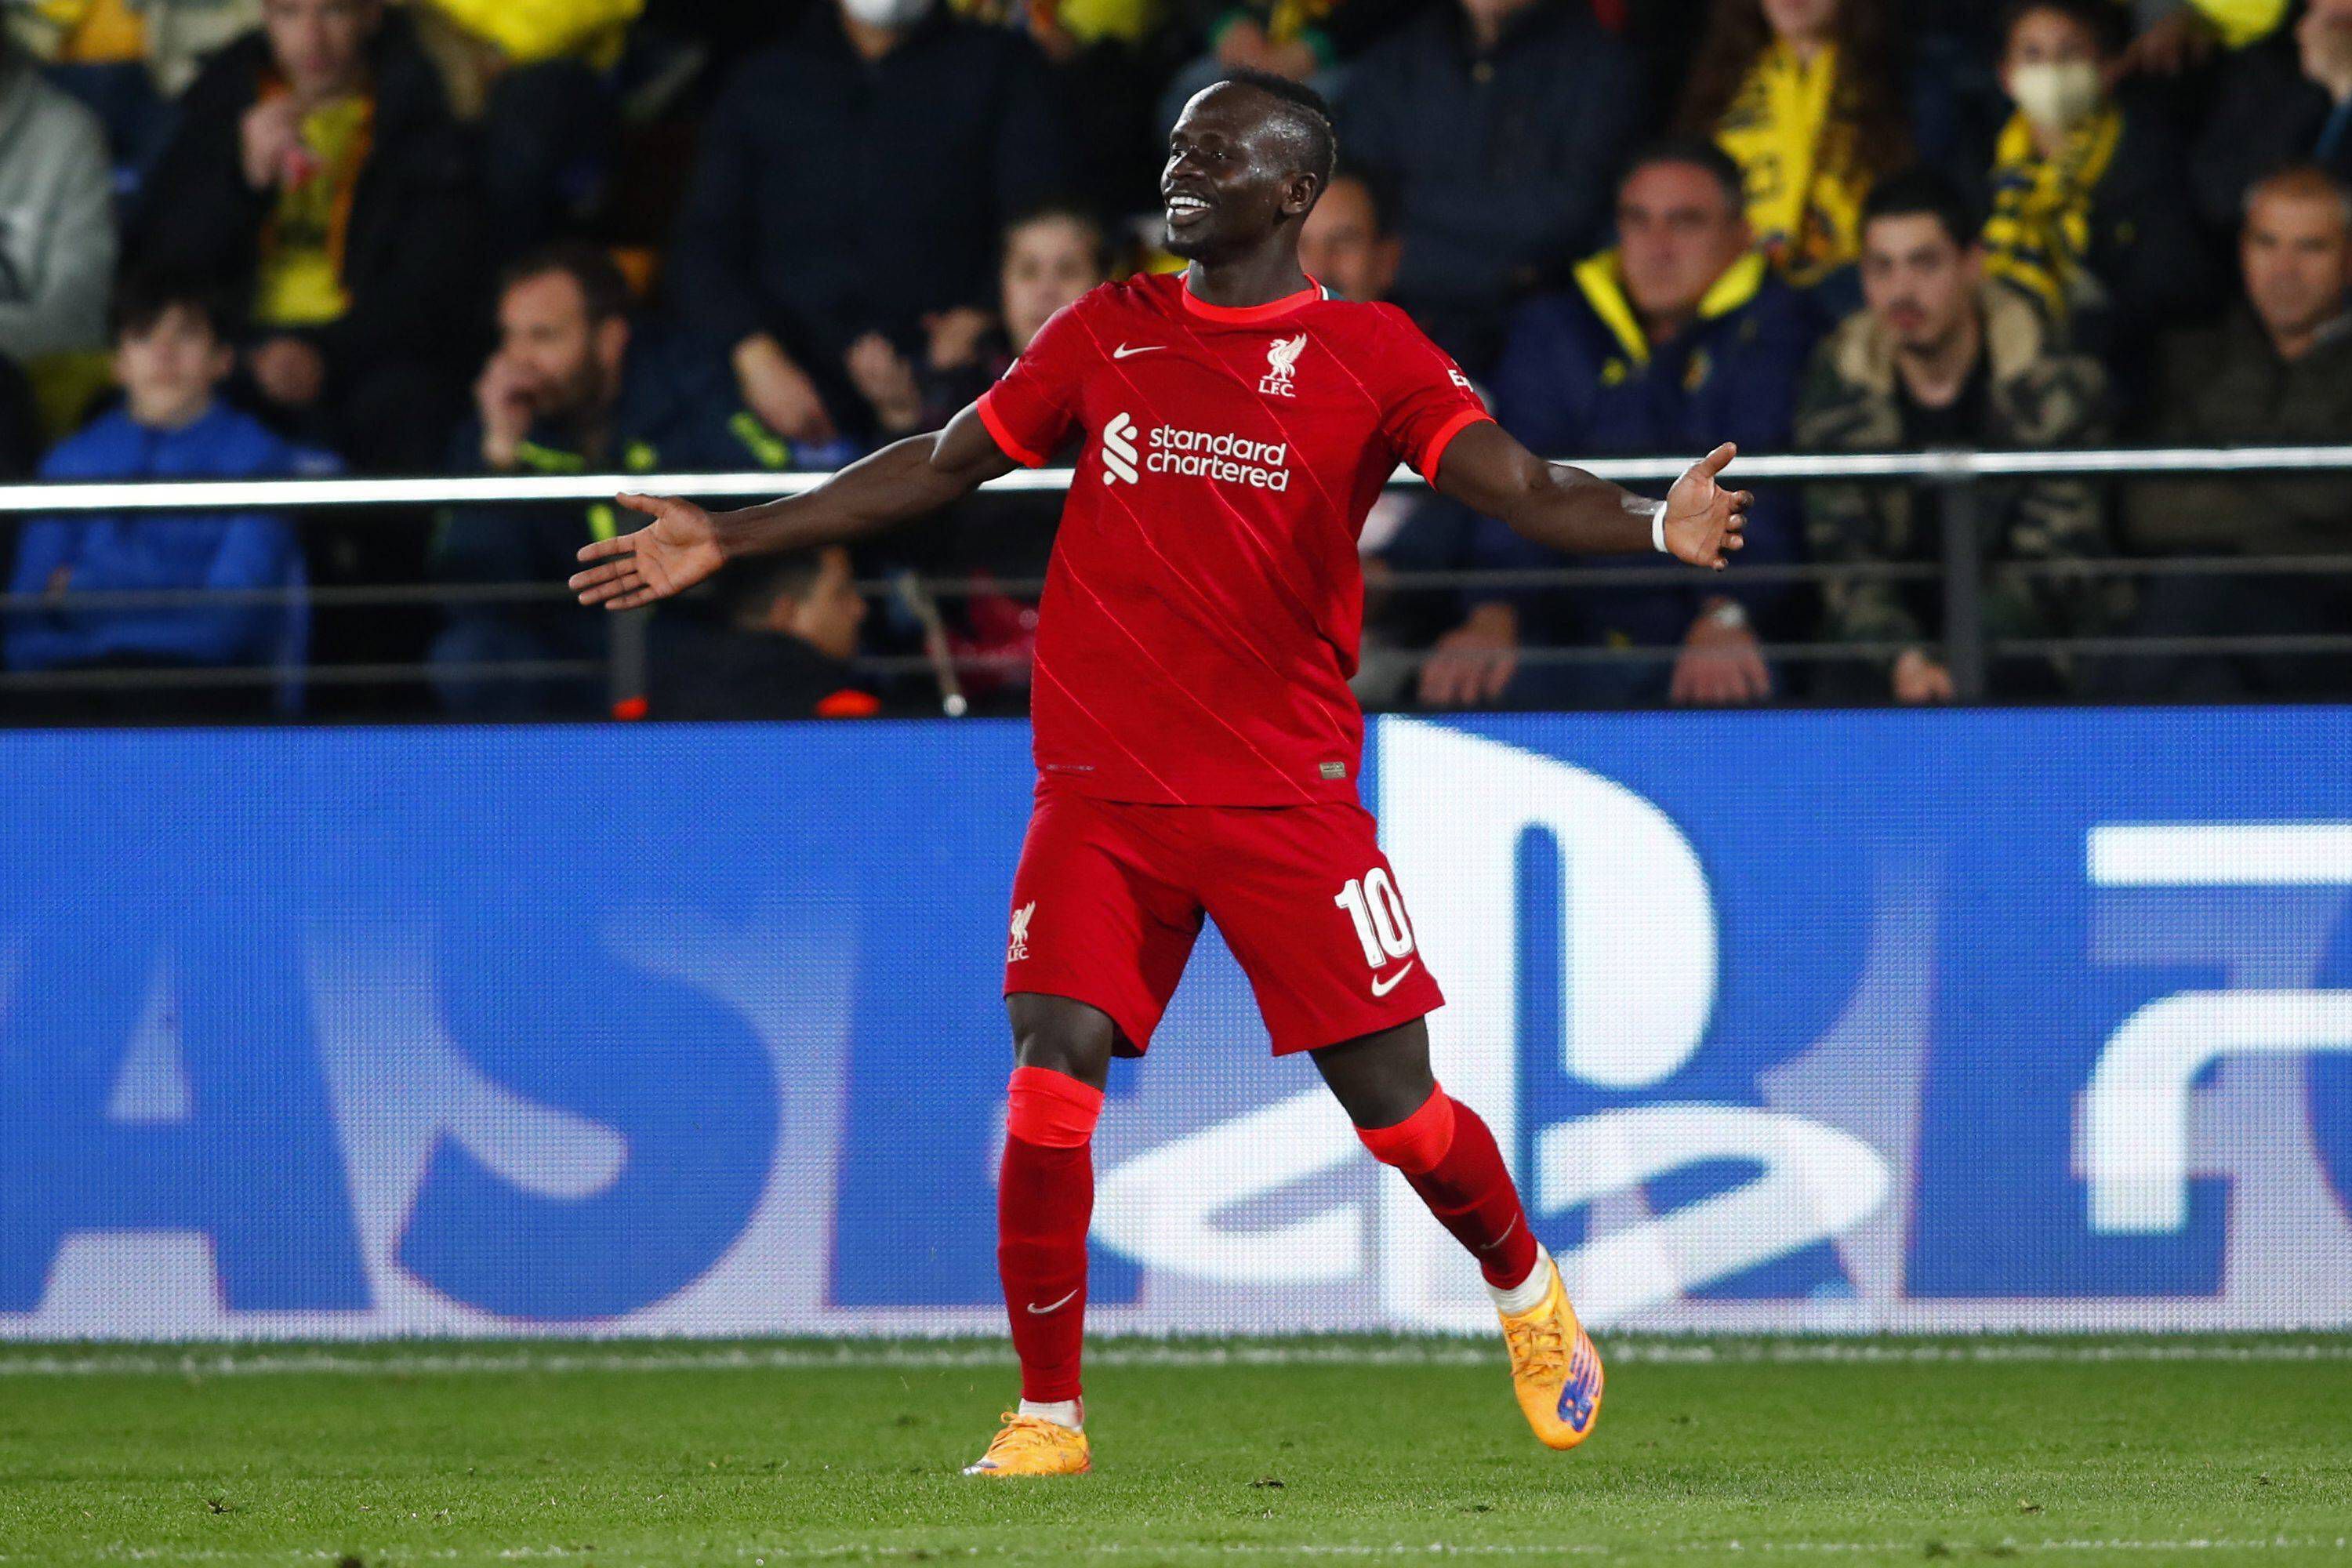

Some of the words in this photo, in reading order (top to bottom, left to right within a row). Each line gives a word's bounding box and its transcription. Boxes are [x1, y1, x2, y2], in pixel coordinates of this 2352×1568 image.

[1149, 424, 1287, 466] standard
[1146, 449, 1290, 492] chartered
[1334, 867, 1414, 968] 10
